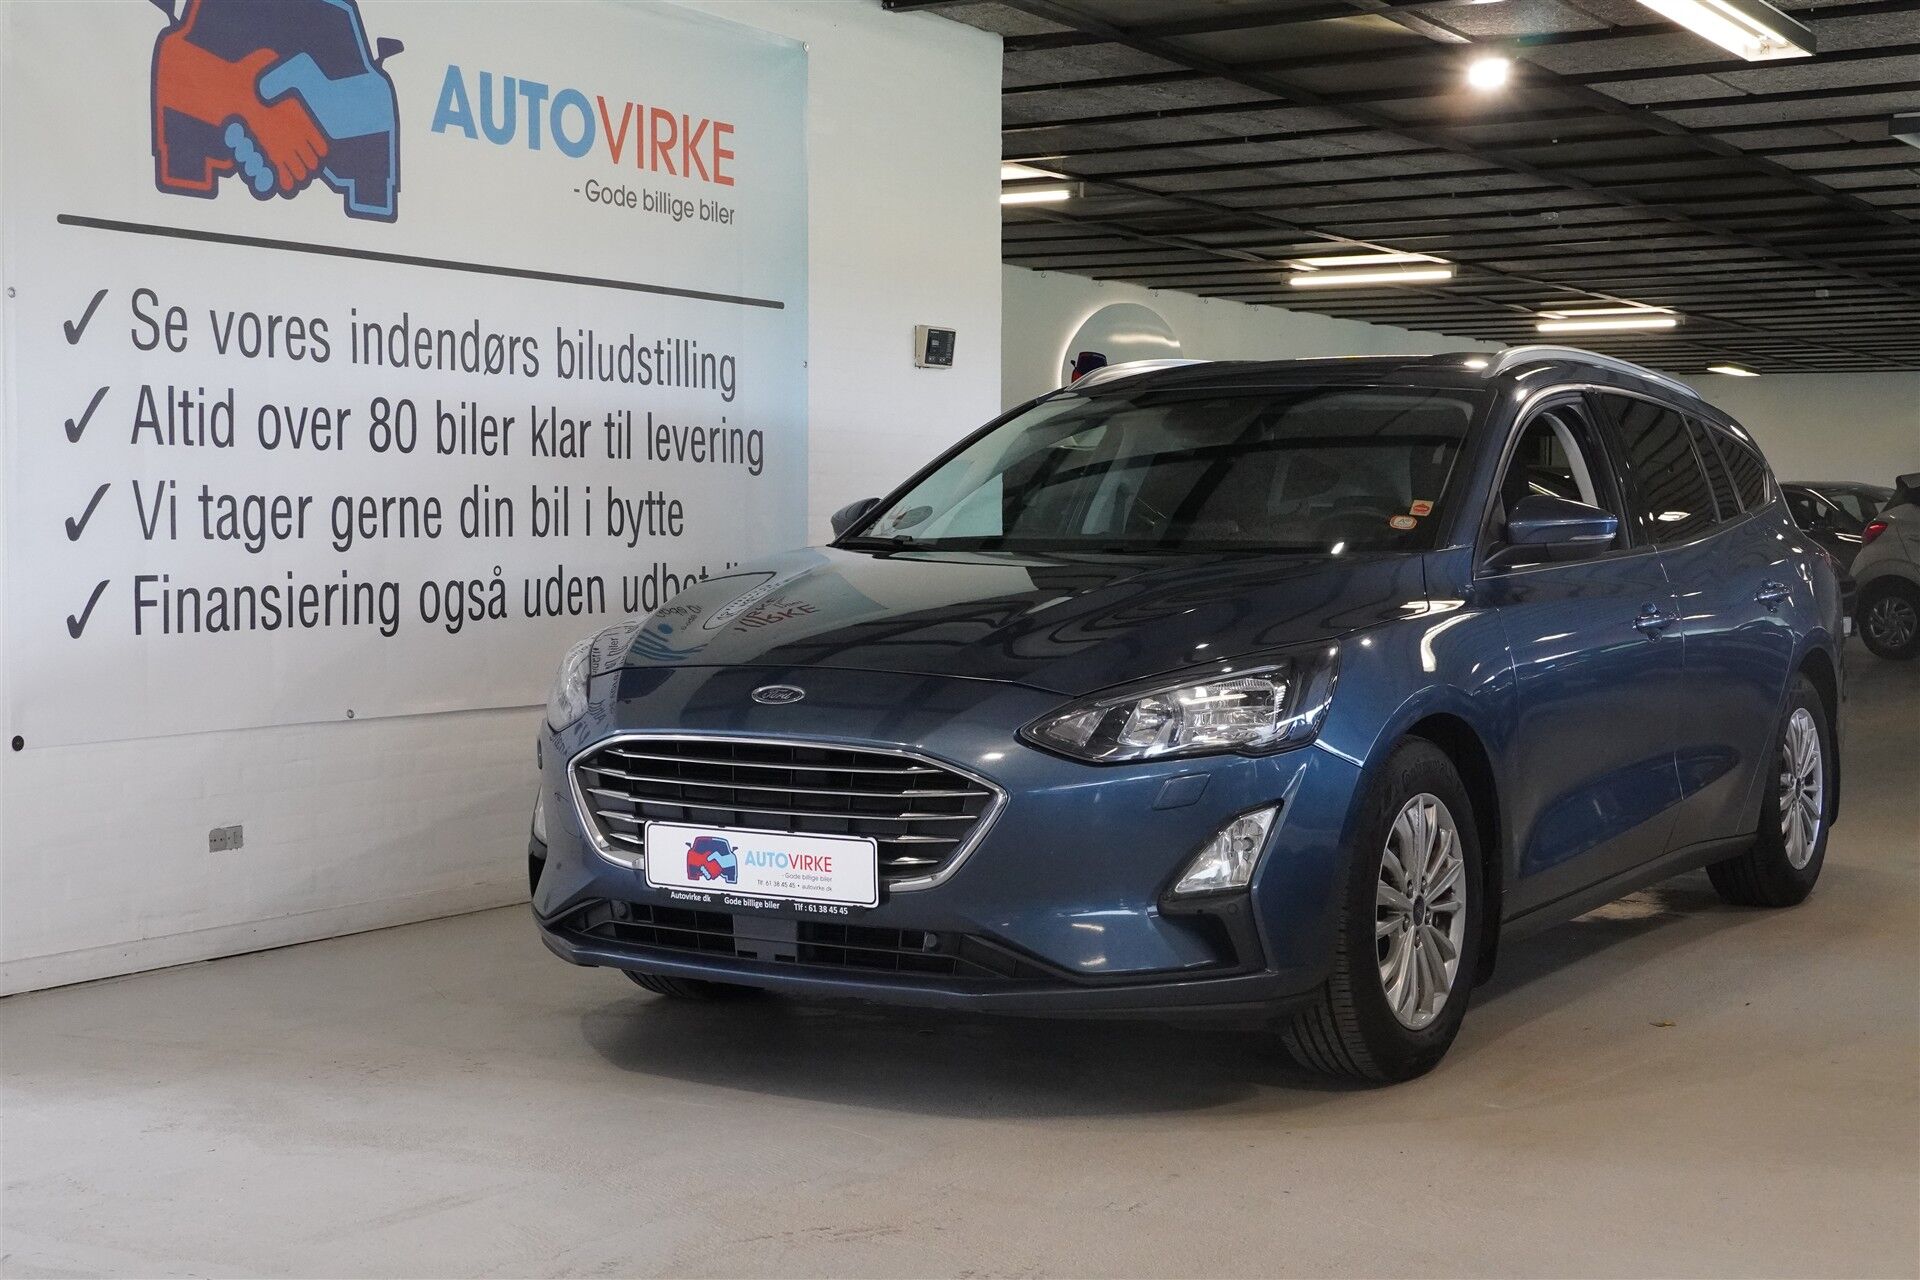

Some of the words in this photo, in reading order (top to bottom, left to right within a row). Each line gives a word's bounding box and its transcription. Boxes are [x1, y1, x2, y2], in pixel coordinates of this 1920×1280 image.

[431, 65, 735, 187] AUTOVIRKE
[585, 179, 637, 208] Gode
[642, 188, 694, 222] billige
[699, 199, 735, 225] biler
[132, 288, 188, 353] Se
[210, 310, 331, 363] vores
[352, 308, 540, 378] indendørs
[557, 327, 737, 402] biludstilling
[131, 385, 234, 449] Altid
[258, 405, 352, 451] over
[370, 397, 417, 454] 80
[437, 400, 516, 457] biler
[532, 406, 592, 459] klar
[604, 411, 632, 461] til
[648, 412, 764, 477] levering
[133, 480, 177, 541] Vi
[198, 485, 313, 553] tager
[332, 496, 442, 553] gerne
[460, 484, 514, 539] din
[532, 485, 569, 538] bil
[585, 485, 592, 537] i
[608, 486, 684, 549] bytte
[135, 569, 400, 638] Finansiering
[420, 565, 507, 635] også
[524, 564, 606, 619] uden
[744, 850, 832, 872] AUTOVIRKE
[785, 872, 801, 880] Gode
[671, 891, 702, 901] Autovirke
[724, 896, 741, 906] Gode
[743, 899, 762, 909] billige
[764, 901, 780, 909] biler
[808, 904, 817, 913] 61
[819, 905, 828, 914] 38
[829, 906, 838, 914] 45
[839, 907, 849, 915] 45
